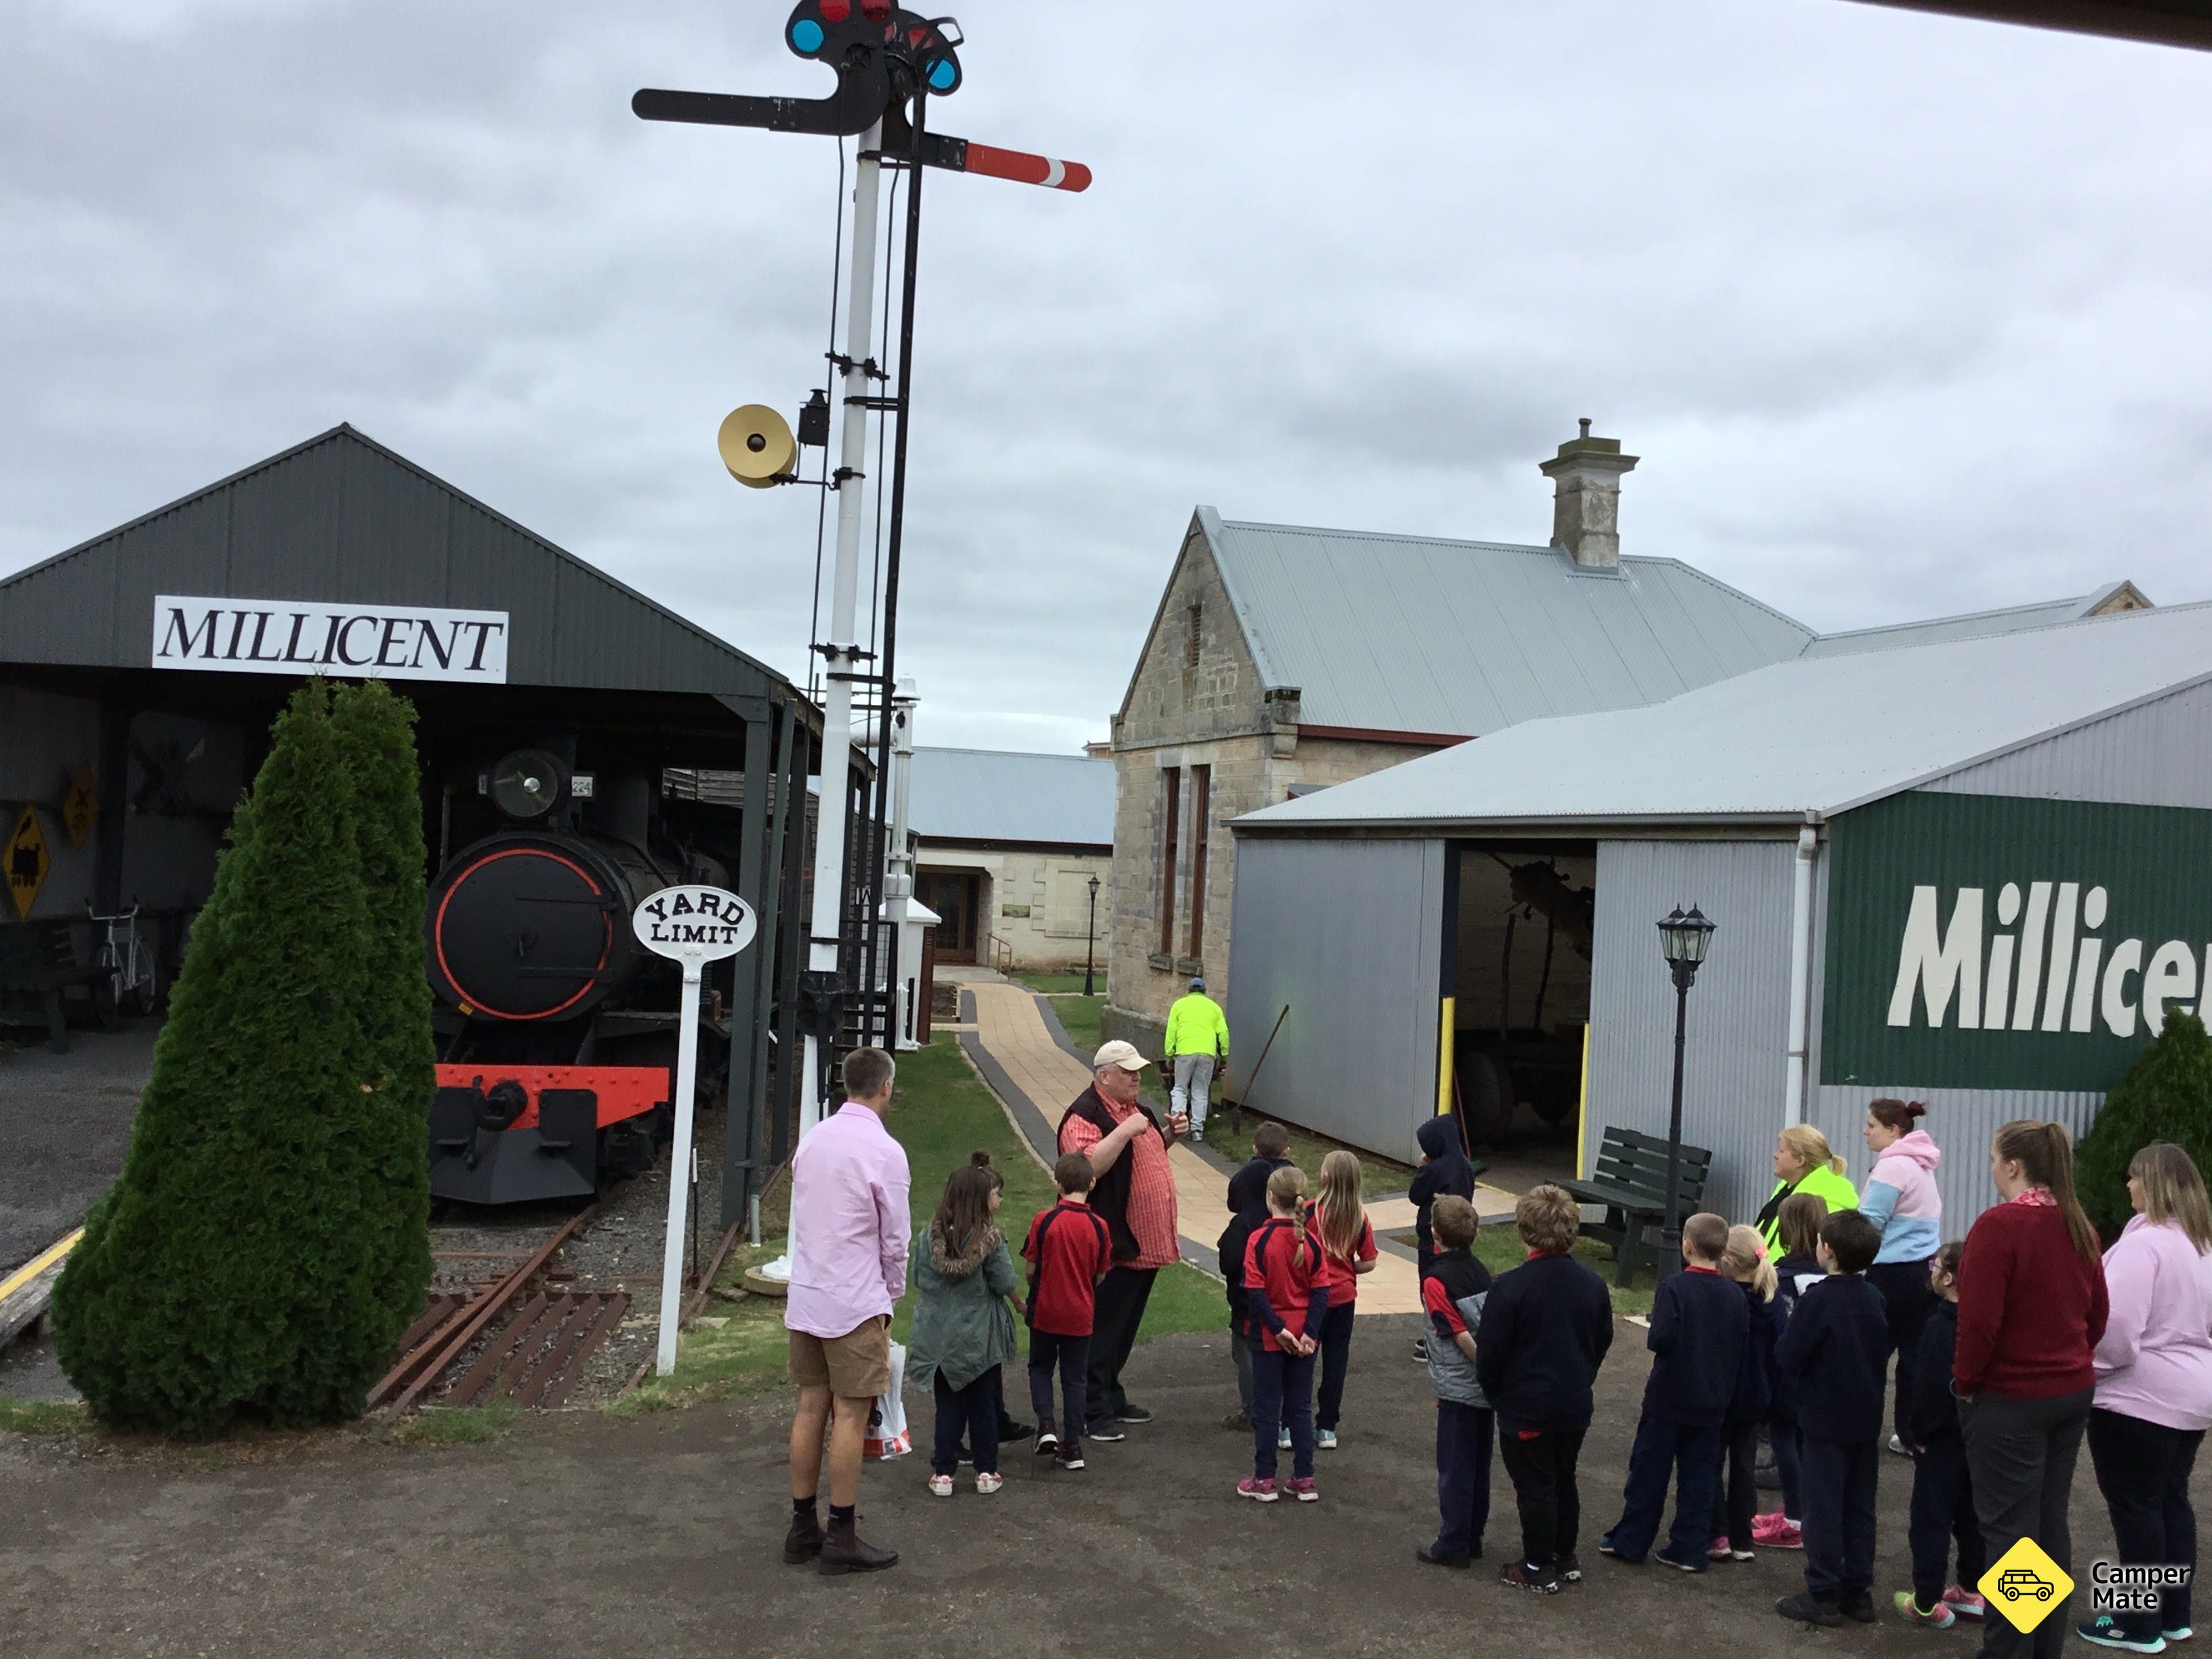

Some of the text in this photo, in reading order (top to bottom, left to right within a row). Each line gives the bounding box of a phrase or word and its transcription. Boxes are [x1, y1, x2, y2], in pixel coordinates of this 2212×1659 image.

[157, 607, 504, 670] MILLICENT
[573, 781, 591, 792] 224
[644, 893, 745, 926] YARD
[651, 923, 738, 944] LIMIT
